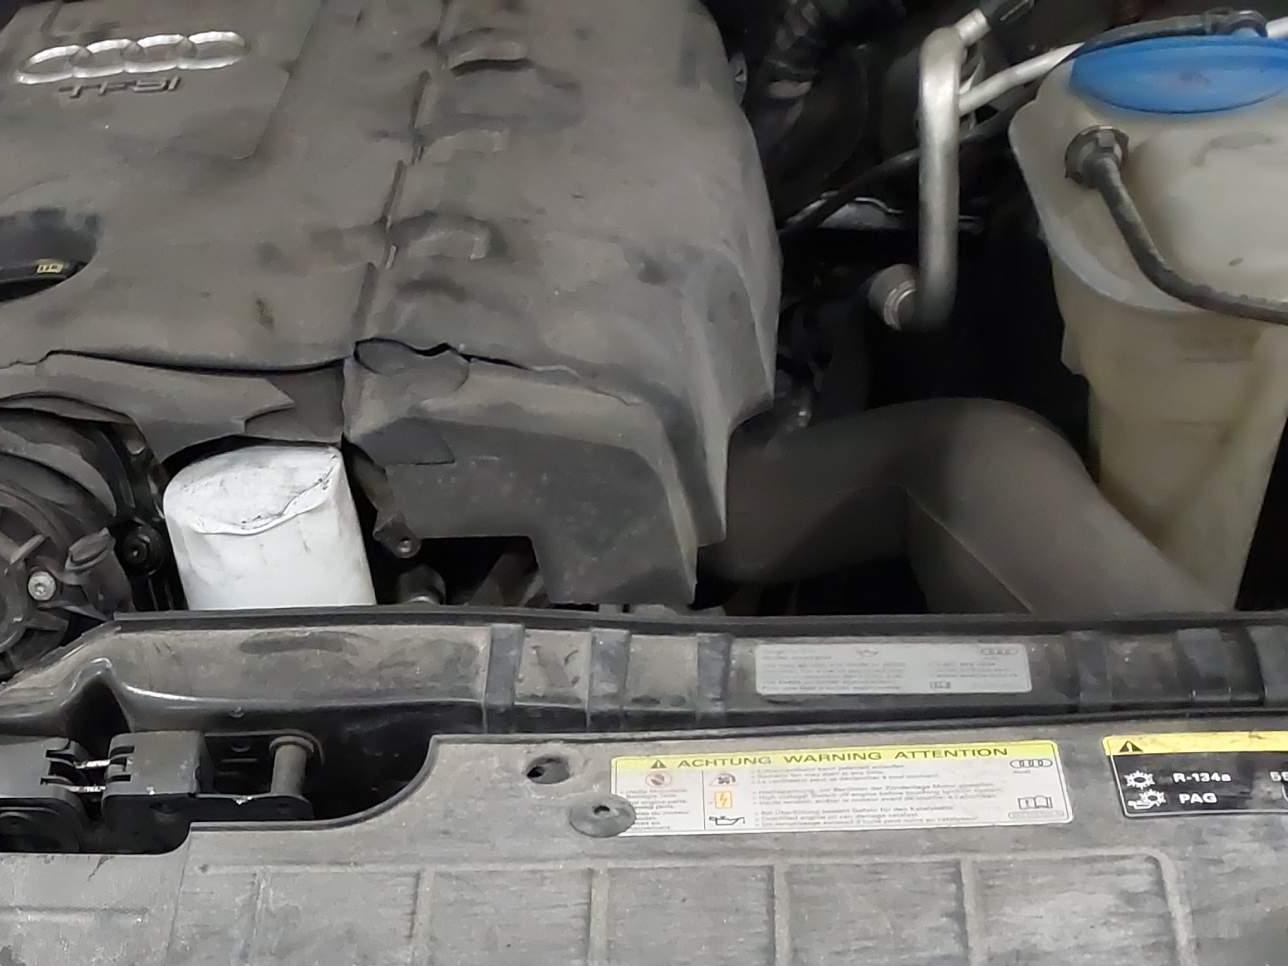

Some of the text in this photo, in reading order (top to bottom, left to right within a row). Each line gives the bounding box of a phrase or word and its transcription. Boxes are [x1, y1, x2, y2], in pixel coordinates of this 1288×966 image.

[677, 748, 1008, 769] ACHTUNG WARNING ATTENTION
[1178, 793, 1217, 804] PAG
